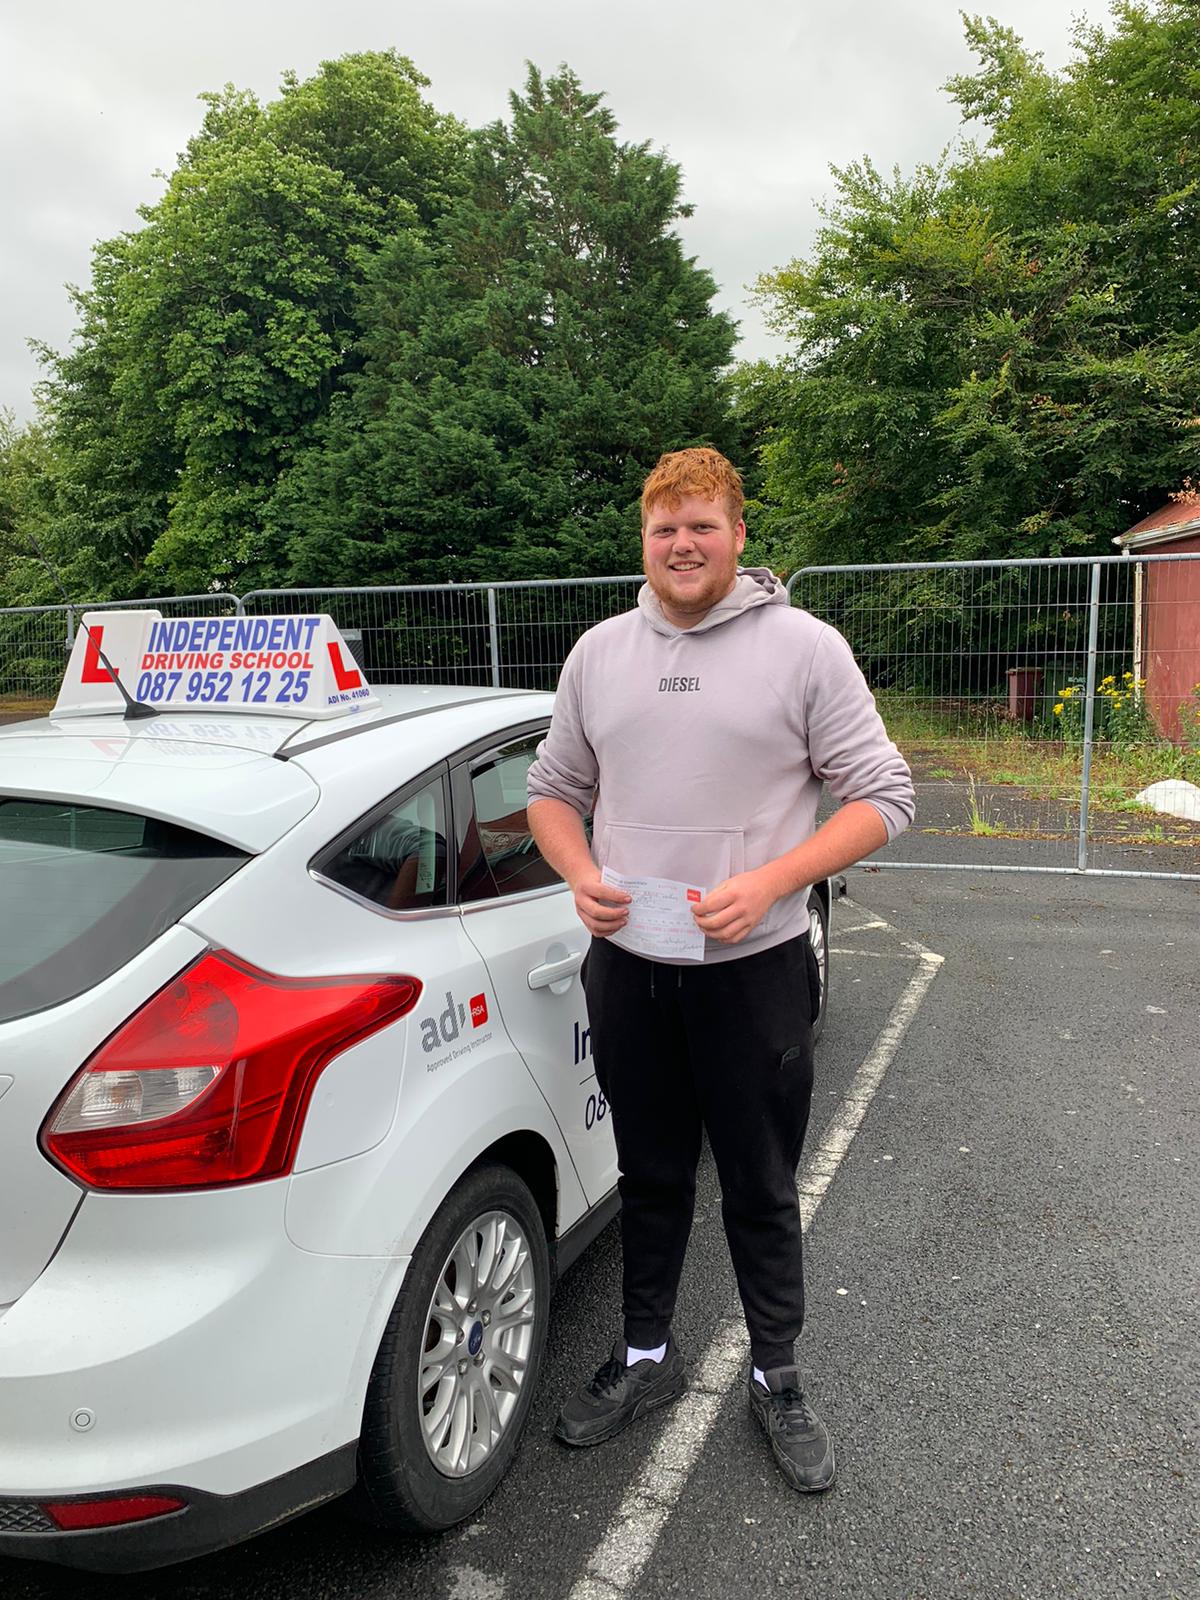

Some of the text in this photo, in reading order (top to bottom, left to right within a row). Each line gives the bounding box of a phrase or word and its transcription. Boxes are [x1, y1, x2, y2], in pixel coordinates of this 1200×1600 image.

[147, 618, 320, 653] INDEPENDENT
[81, 626, 120, 684] L
[141, 652, 313, 670] DRIVING SCHOOL
[327, 641, 363, 691] L
[136, 671, 311, 703] 087 952 12 25
[328, 695, 339, 704] ADI
[340, 694, 351, 702] No.
[658, 676, 701, 692] DIESEL
[427, 1031, 492, 1073] Approved Driving Instructor
[574, 1021, 593, 1066] In
[585, 1090, 612, 1131] 08
